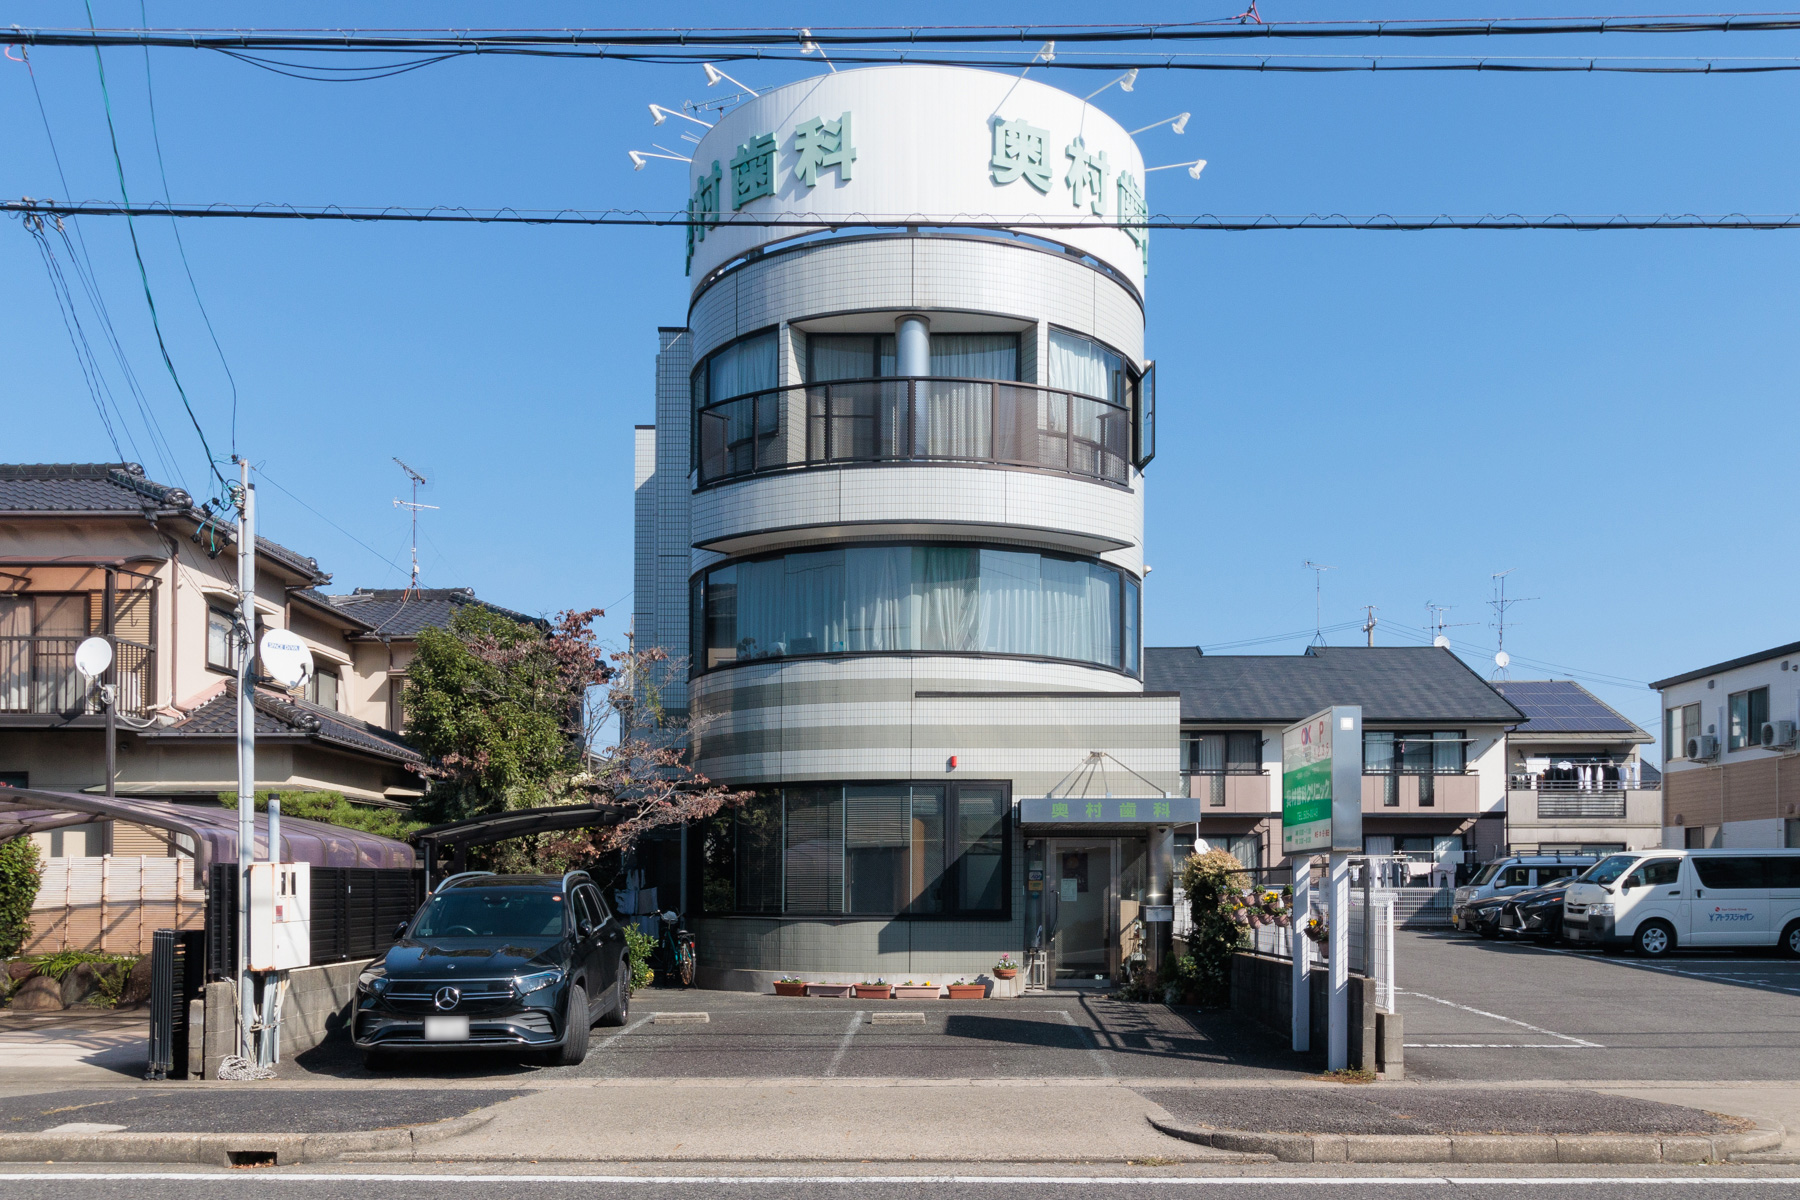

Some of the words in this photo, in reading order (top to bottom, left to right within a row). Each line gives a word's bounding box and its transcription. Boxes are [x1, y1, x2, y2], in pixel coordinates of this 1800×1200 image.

[685, 111, 857, 276] 村歯科
[991, 115, 1149, 278] 奥村歯
[1319, 721, 1324, 743] P
[1051, 802, 1170, 818] 奥村歯科
[1715, 913, 1754, 921] アトラスジャパン
